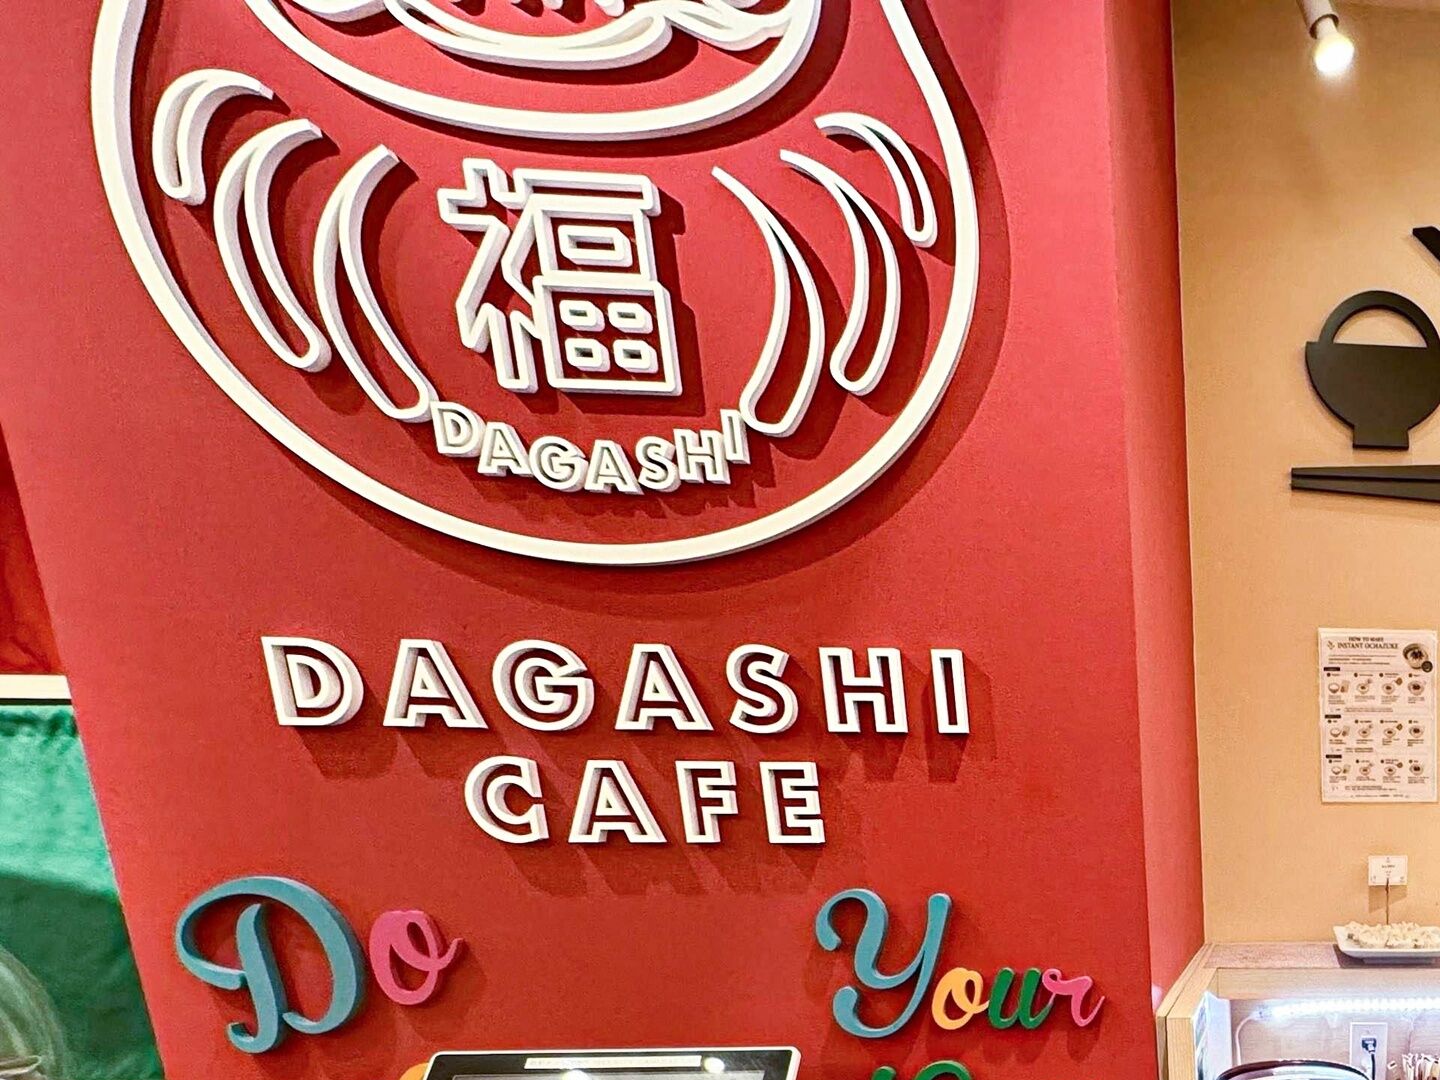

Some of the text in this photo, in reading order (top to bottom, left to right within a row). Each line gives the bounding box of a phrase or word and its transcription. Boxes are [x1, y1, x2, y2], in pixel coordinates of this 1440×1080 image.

[439, 157, 682, 394] 福
[430, 401, 751, 495] DAGASHI
[261, 635, 971, 735] DAGASHI
[1337, 642, 1363, 650] INSTANT
[465, 755, 826, 845] CAFE
[175, 875, 464, 1054] Do
[815, 887, 1105, 1039] Your
